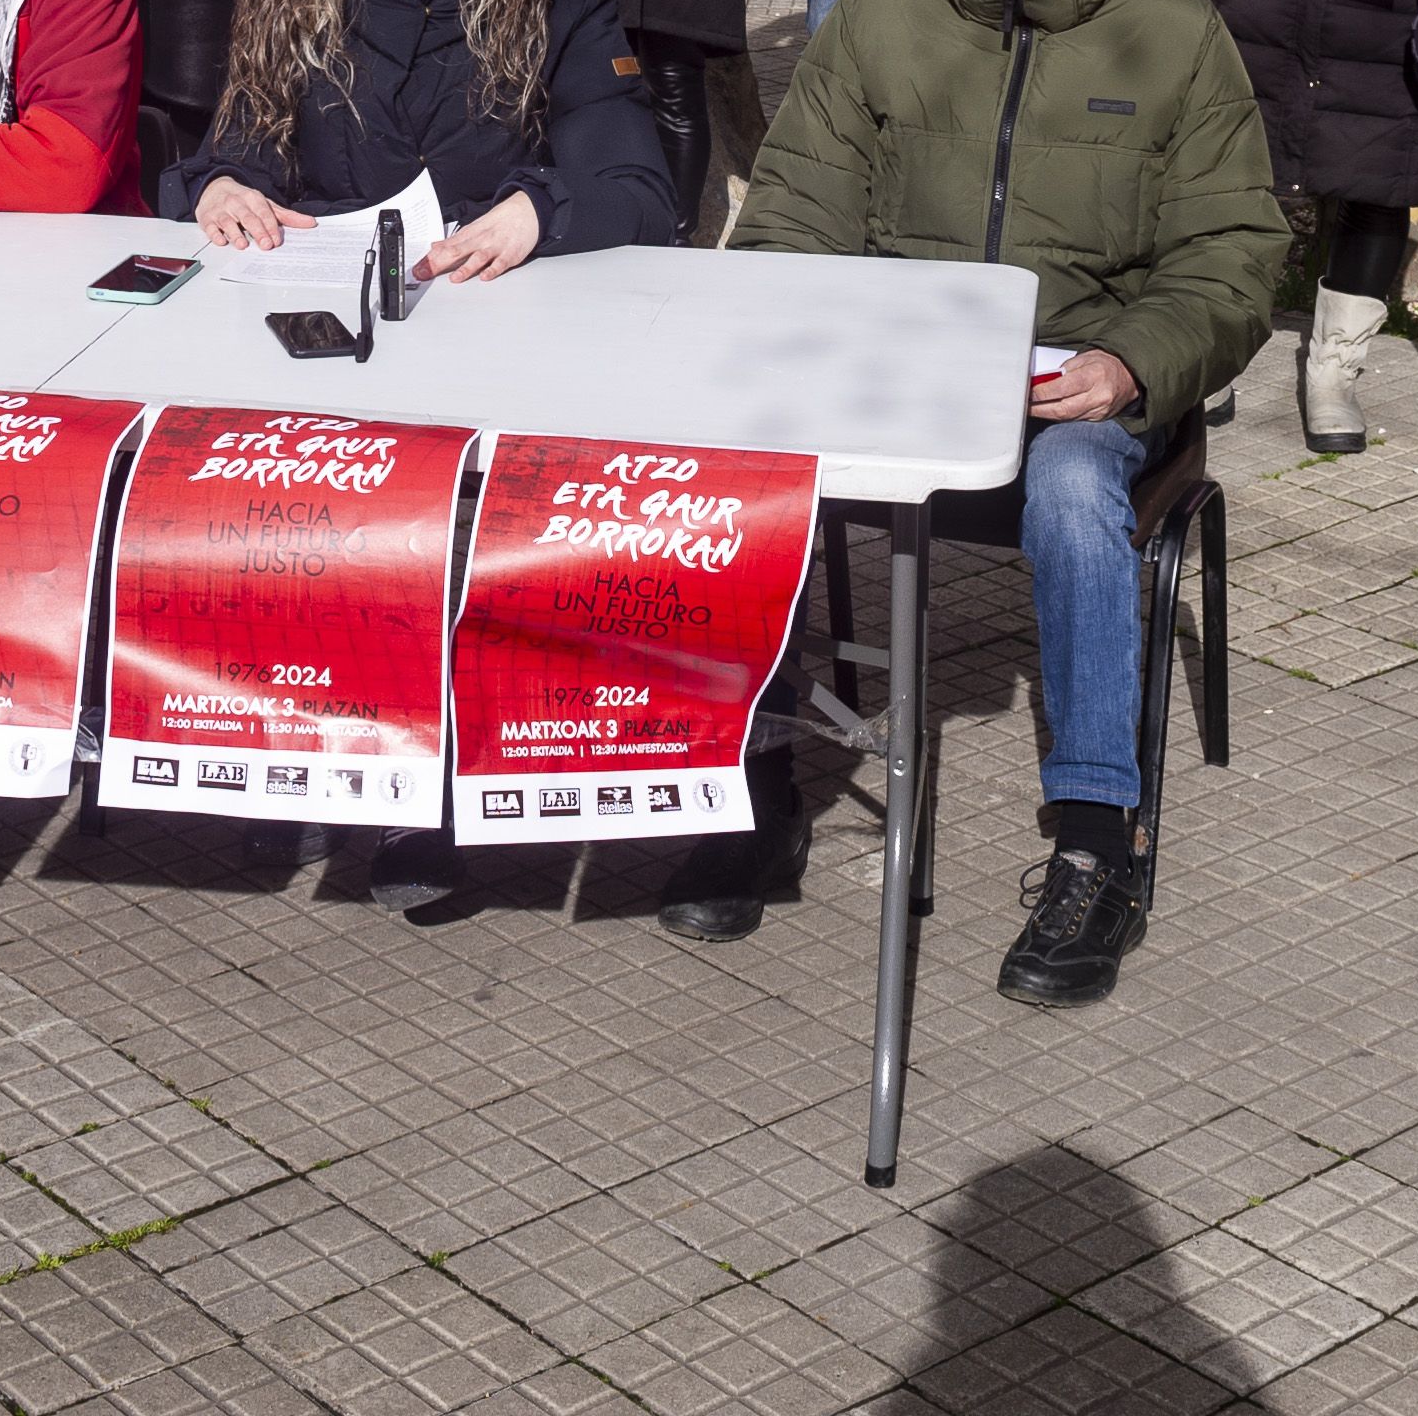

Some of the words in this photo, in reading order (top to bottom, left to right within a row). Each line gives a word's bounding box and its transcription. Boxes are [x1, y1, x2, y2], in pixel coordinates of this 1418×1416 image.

[265, 416, 359, 432] ATZO
[211, 433, 287, 455] ETA
[295, 436, 398, 460] GAUR
[188, 455, 396, 494] BORROKAN
[603, 453, 699, 484] ATZO
[553, 481, 633, 520] ETA
[640, 490, 743, 535] GAUR
[533, 515, 744, 572] BORROKAN
[271, 665, 332, 687] 2024
[162, 694, 277, 716] MARTXOAK
[283, 697, 295, 716] 3
[595, 686, 650, 707] 2024
[502, 720, 601, 740] MARTXOAK
[606, 719, 618, 739] 3
[502, 746, 529, 758] 12:00
[201, 764, 246, 781] LAB
[542, 791, 578, 808] LAB
